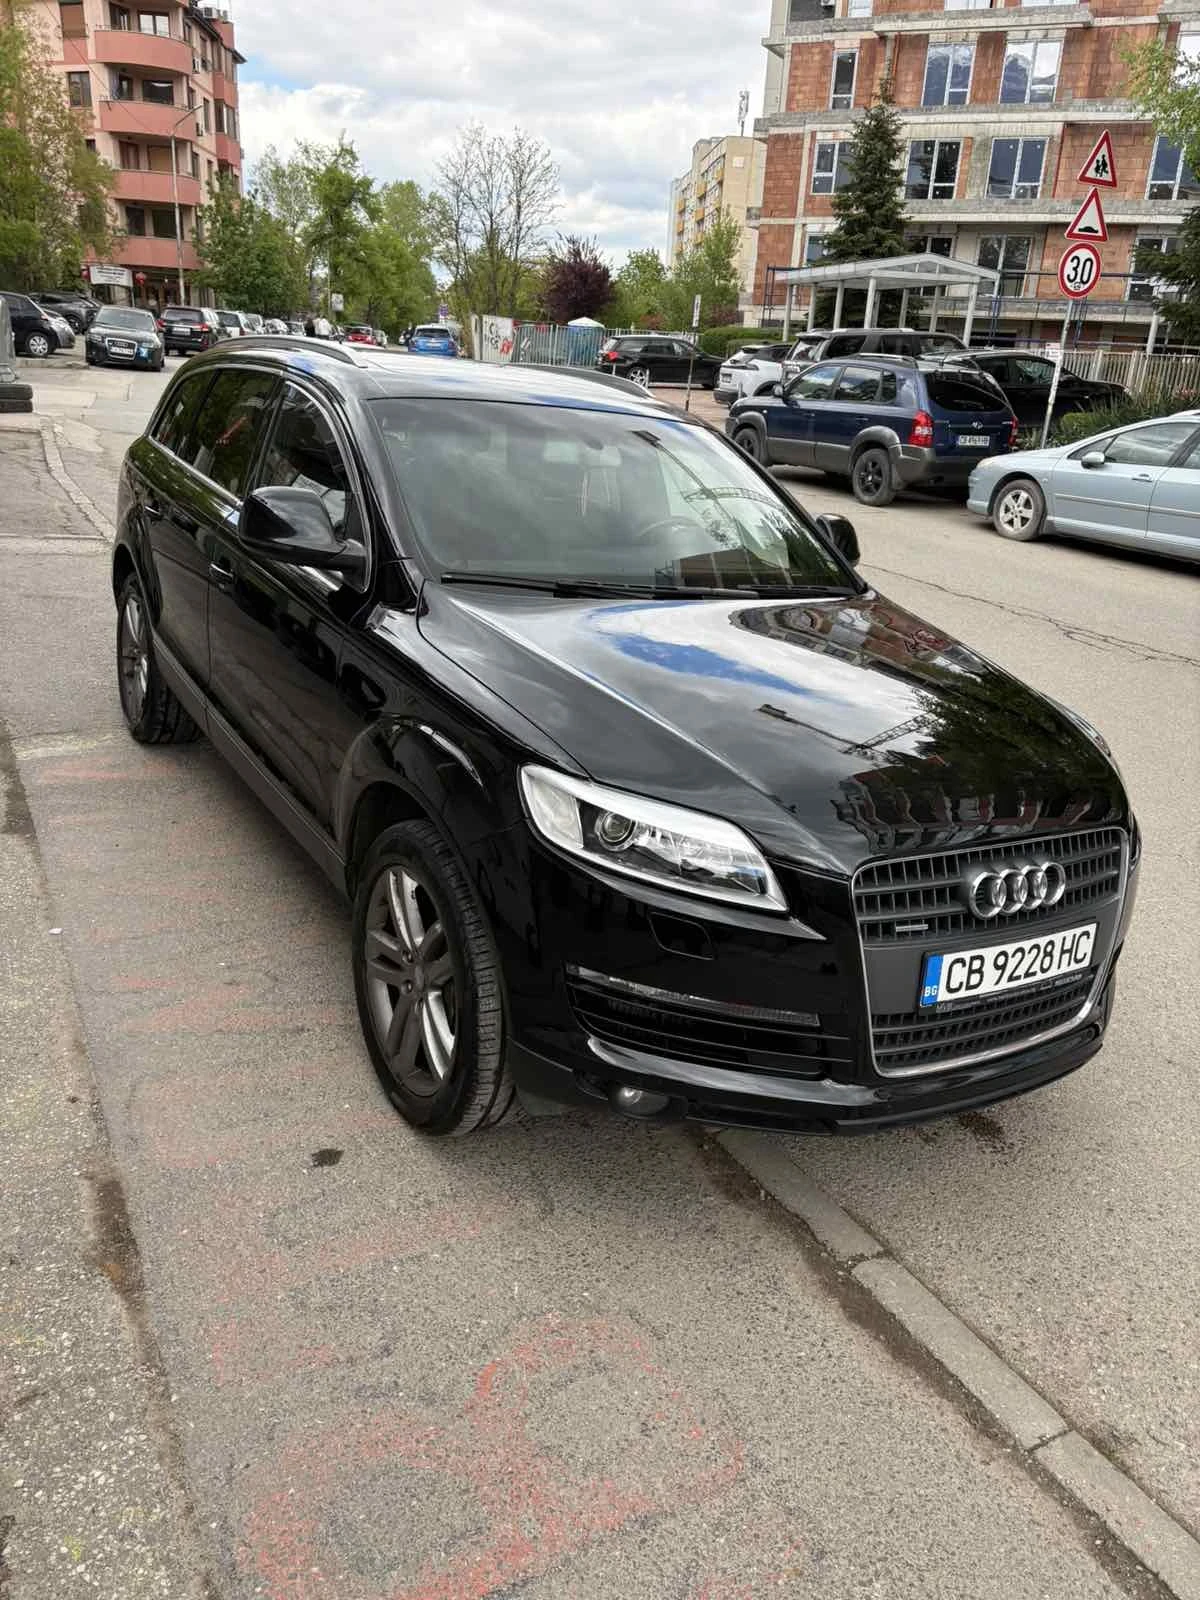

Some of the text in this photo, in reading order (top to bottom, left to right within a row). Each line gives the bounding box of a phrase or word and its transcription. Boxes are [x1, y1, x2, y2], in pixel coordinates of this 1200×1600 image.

[1067, 255, 1094, 285] 30
[945, 954, 985, 994] CB
[993, 939, 1055, 986] 9228
[1057, 930, 1091, 970] HC
[924, 985, 938, 997] BG
